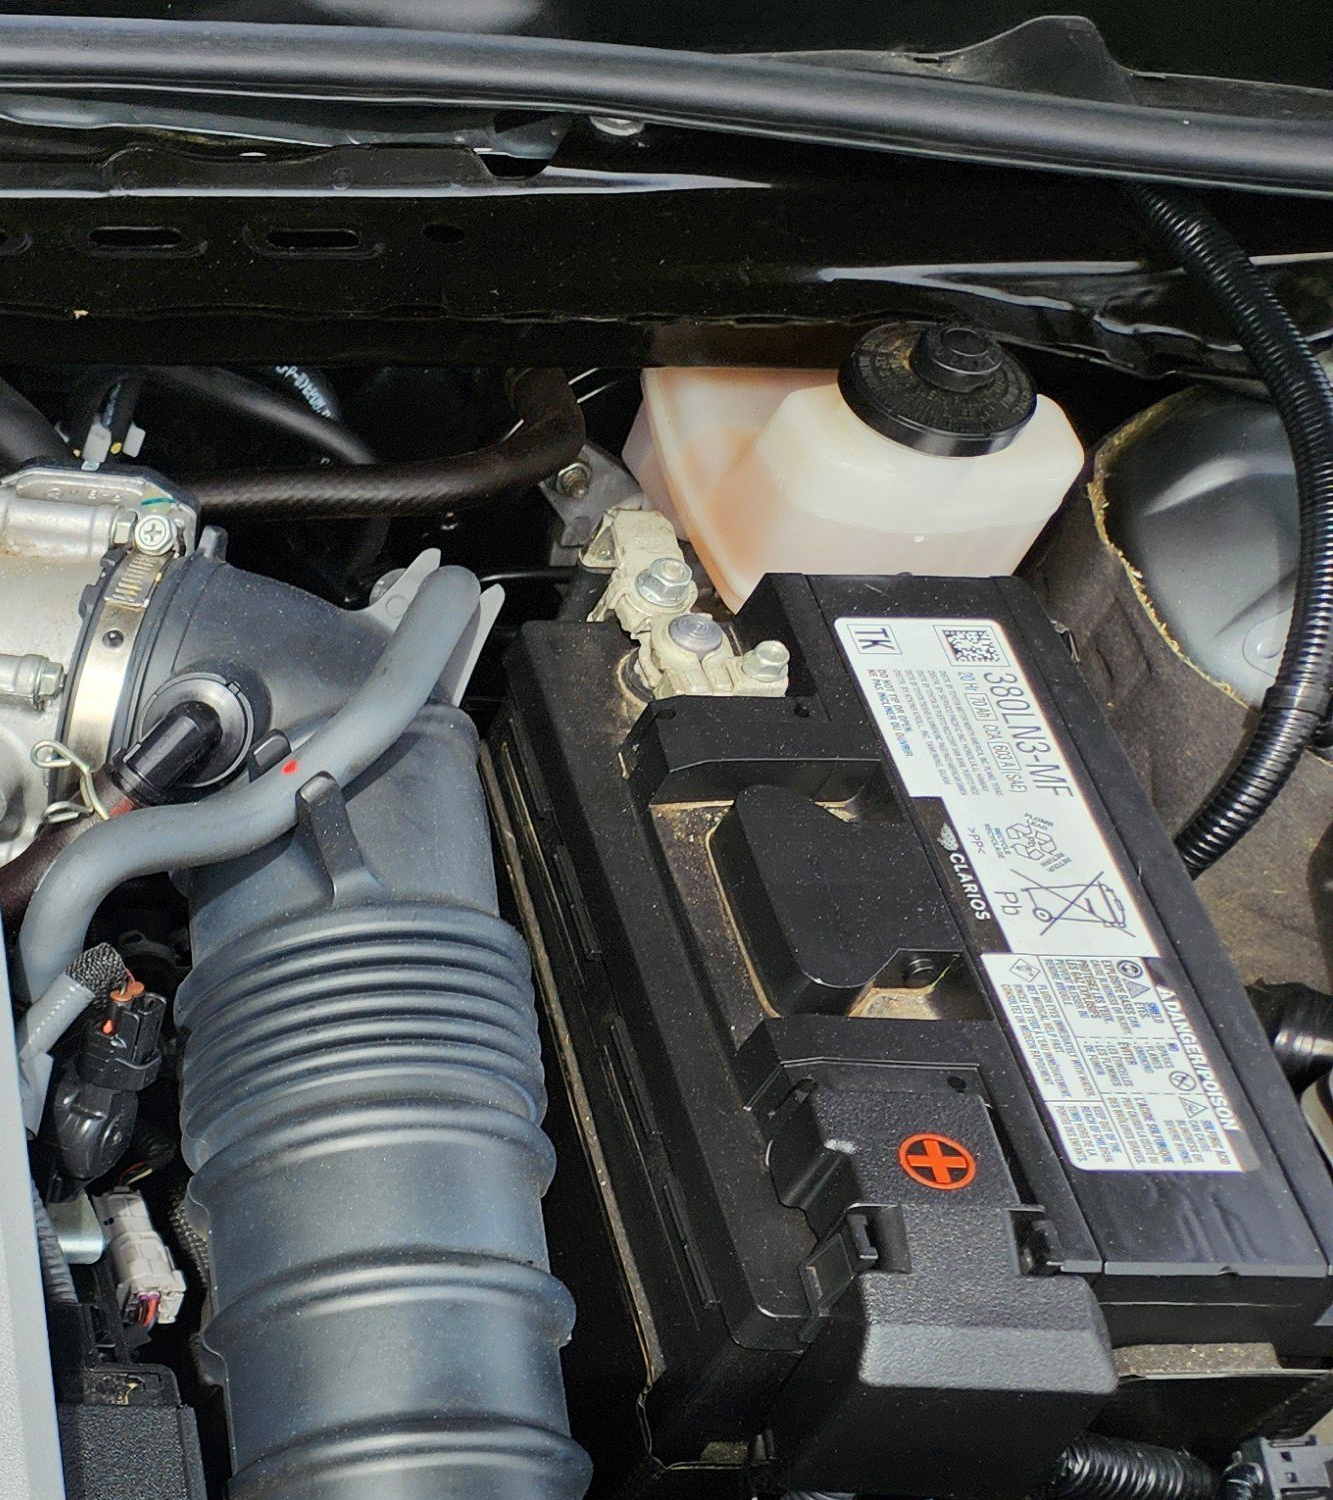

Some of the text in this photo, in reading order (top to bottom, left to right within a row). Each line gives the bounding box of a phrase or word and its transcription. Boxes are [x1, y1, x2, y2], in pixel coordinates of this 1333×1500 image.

[851, 628, 894, 649] TK
[969, 697, 988, 705] 70
[974, 707, 993, 717] Ah
[981, 672, 1072, 796] 380LN3-MF
[991, 745, 1013, 759] 603
[999, 771, 1030, 792] (SAE)
[949, 852, 992, 921] CLARIOS
[993, 891, 1024, 916] Pb
[1090, 992, 1106, 1003] LES
[1165, 1000, 1239, 1131] DANGER/POISON
